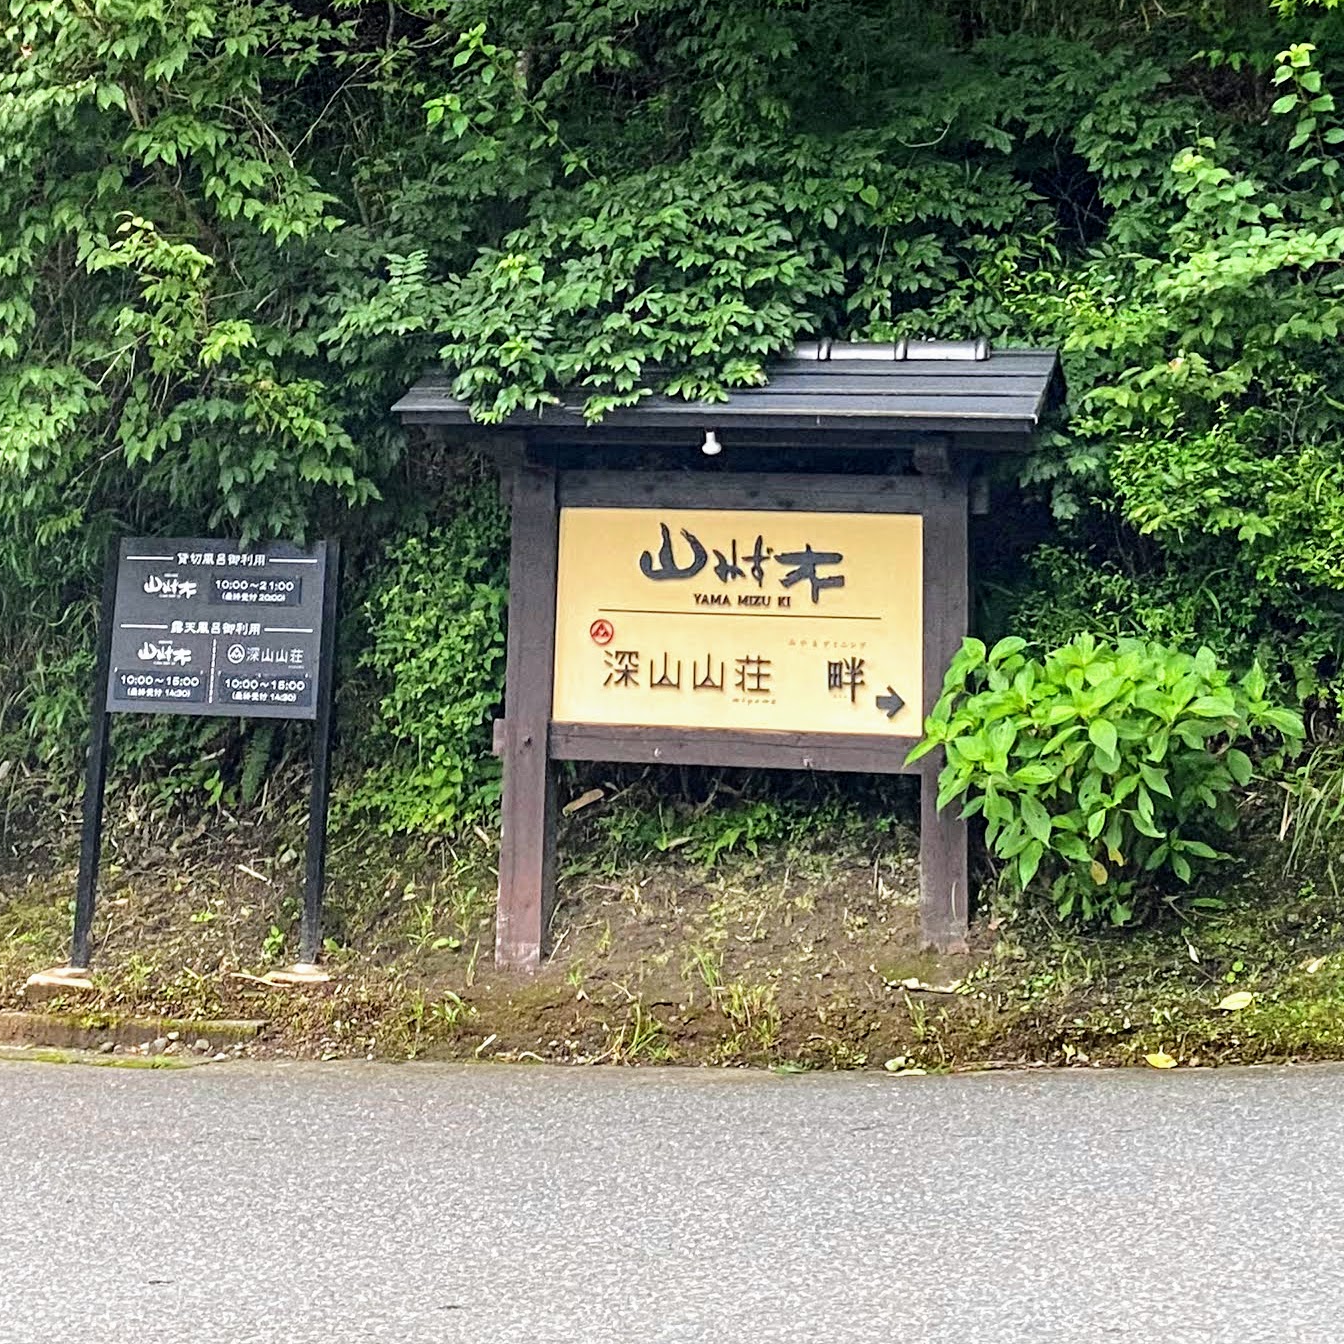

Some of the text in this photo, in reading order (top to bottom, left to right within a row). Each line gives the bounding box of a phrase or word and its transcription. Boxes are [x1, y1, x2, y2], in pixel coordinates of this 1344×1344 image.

[177, 552, 266, 566] 貸切風呂御利用
[693, 593, 792, 607] YAMA MIZU KI
[170, 620, 261, 636] 露天風呂御利用
[246, 646, 304, 664] 深山山荘
[602, 649, 773, 694] 深山山荘
[827, 656, 866, 704] 畔
